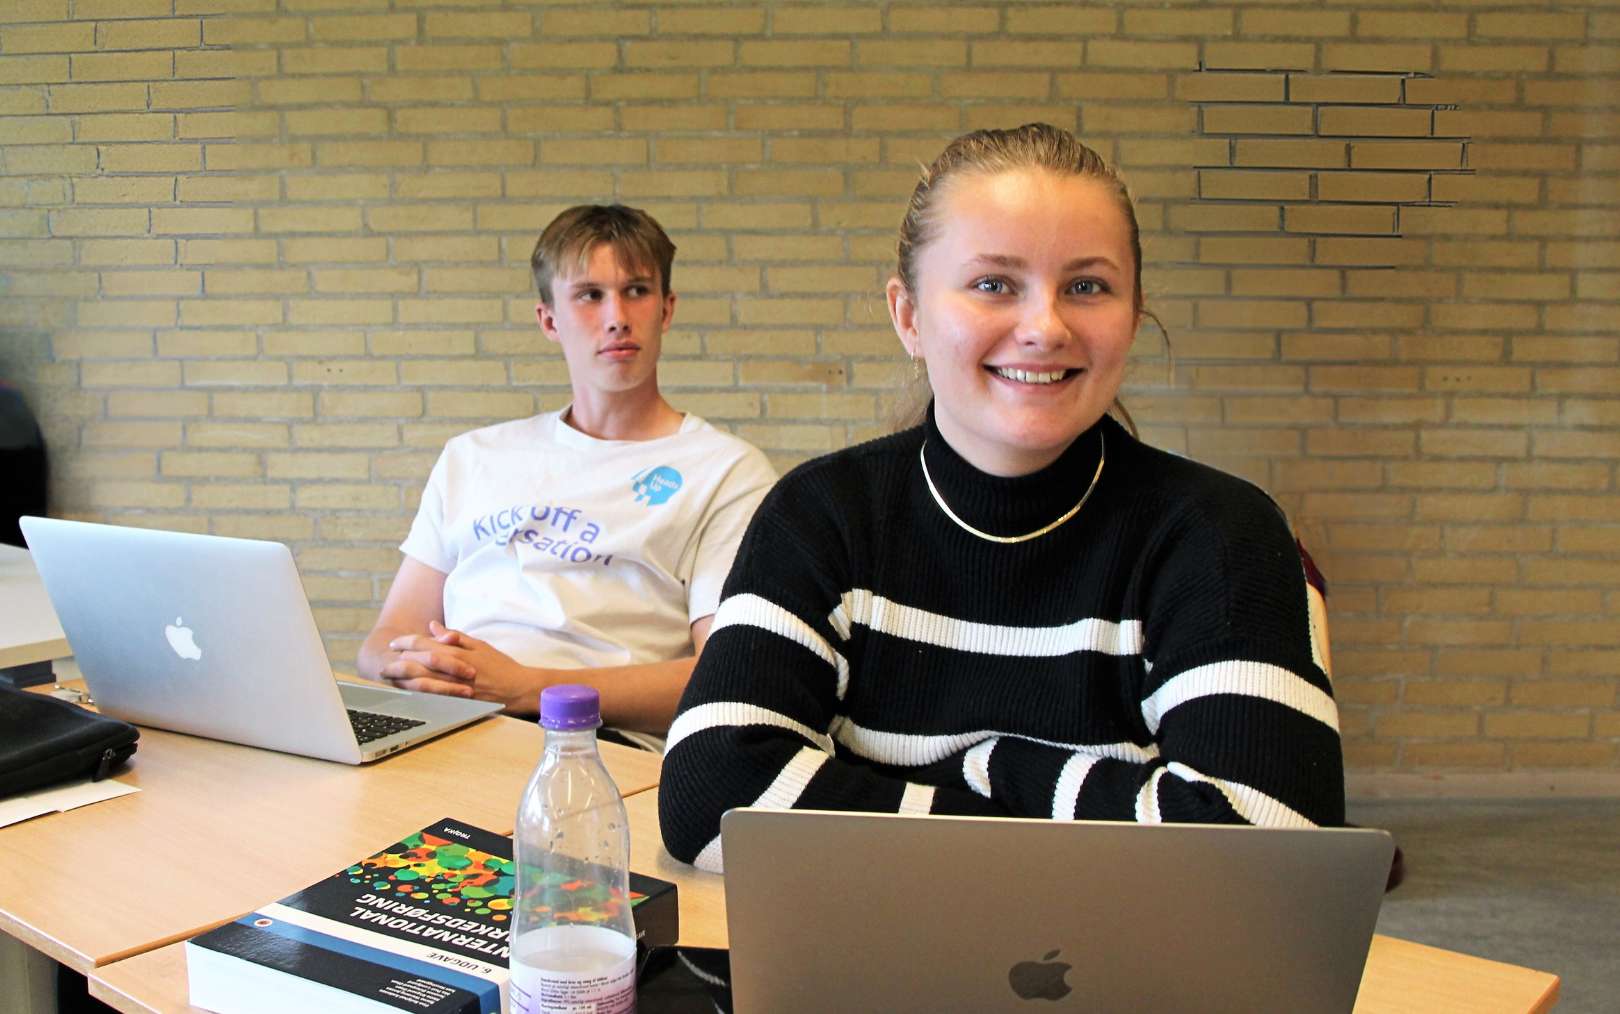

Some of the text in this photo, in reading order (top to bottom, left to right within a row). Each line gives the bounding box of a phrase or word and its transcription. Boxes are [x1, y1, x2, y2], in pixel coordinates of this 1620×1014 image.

[580, 522, 601, 544] a
[350, 906, 510, 959] NTERNATIONAL
[355, 893, 510, 942] RKEDSFØRING
